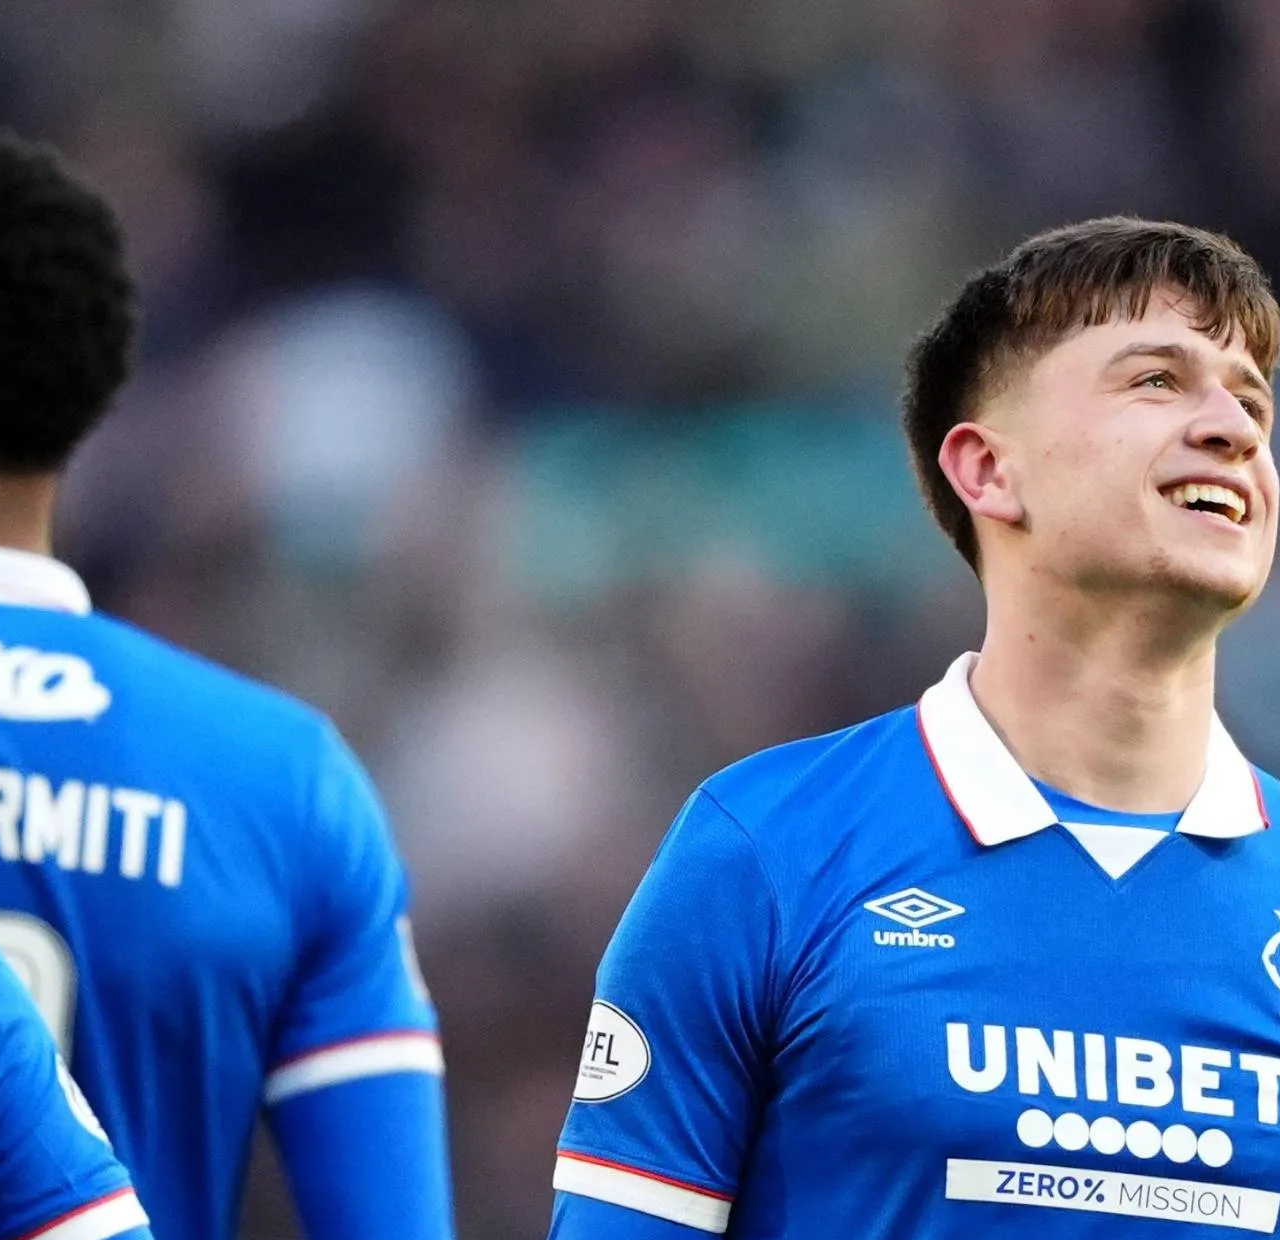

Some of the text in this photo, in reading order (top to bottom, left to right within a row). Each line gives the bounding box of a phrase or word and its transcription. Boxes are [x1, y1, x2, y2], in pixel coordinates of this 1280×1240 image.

[873, 929, 956, 949] umbro
[995, 1170, 1242, 1220] ZERO% MISSION
